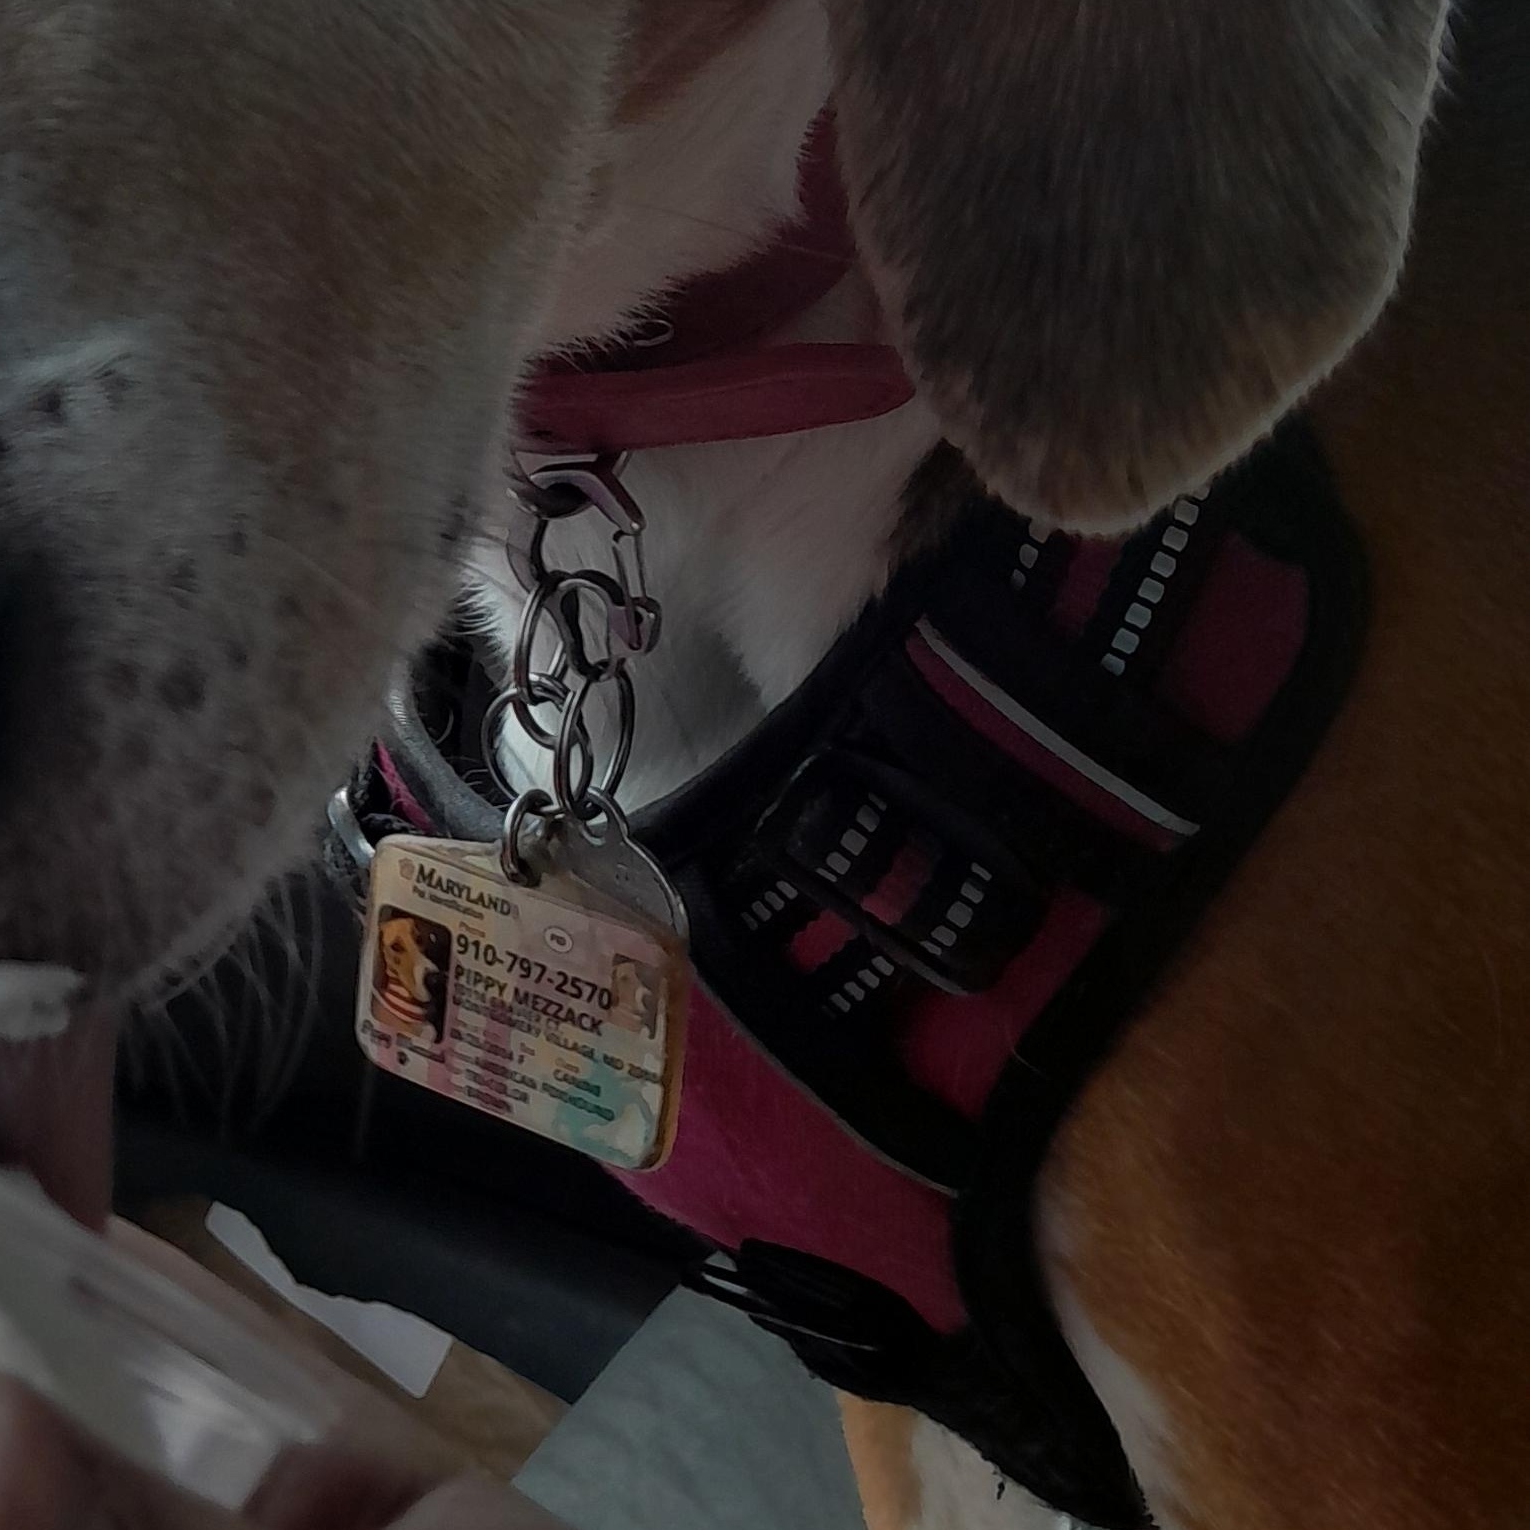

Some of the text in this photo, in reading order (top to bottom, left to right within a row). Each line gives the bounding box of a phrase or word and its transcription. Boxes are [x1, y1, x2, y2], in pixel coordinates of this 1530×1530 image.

[416, 863, 511, 916] MARYLAND
[454, 964, 508, 997] PIPPY
[456, 934, 612, 1010] 910-797-2570
